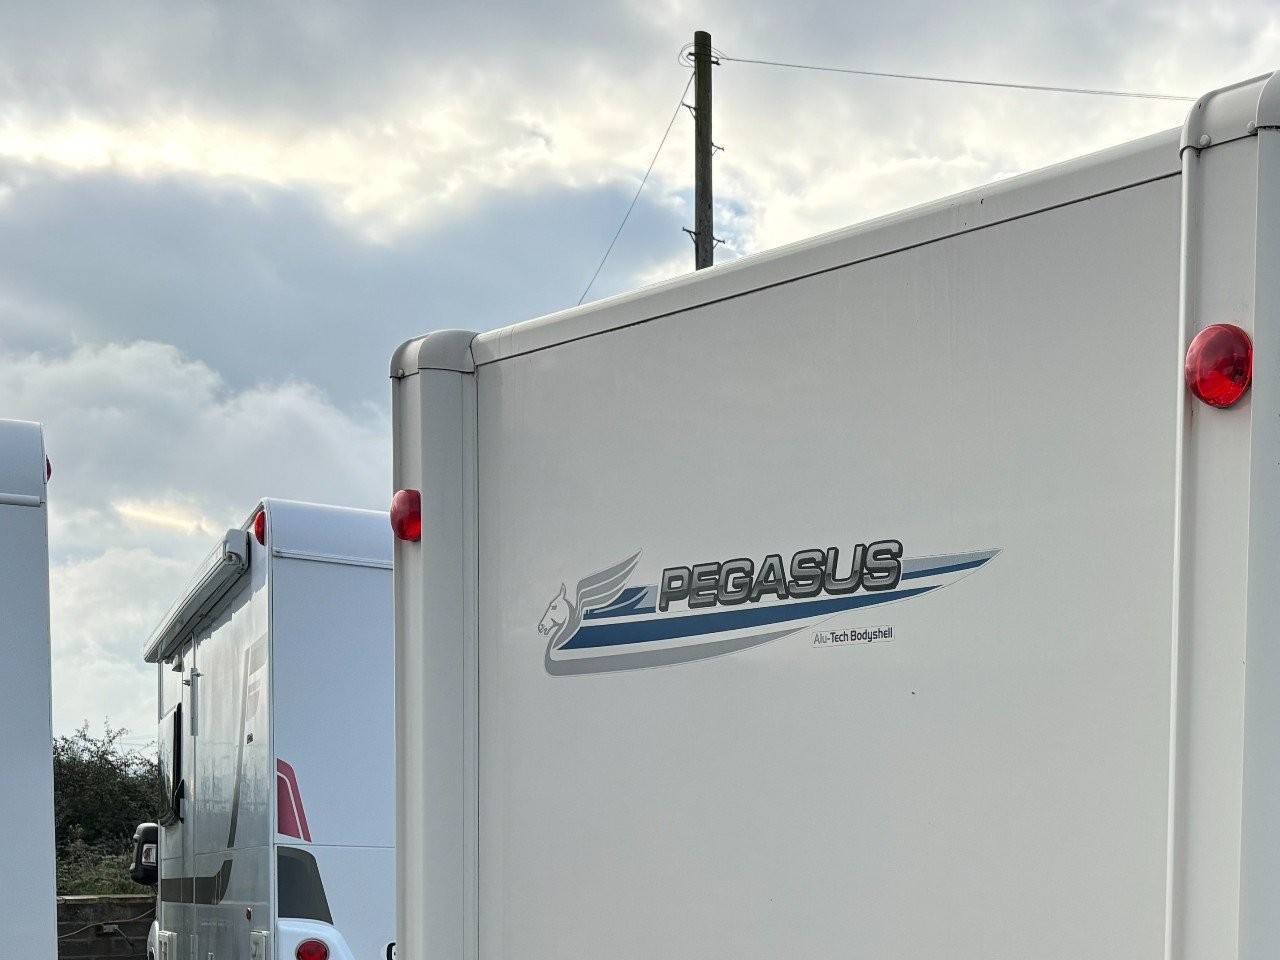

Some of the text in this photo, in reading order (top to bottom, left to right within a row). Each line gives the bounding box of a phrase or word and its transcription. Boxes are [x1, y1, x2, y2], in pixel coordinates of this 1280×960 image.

[657, 540, 903, 612] PEGASUS
[813, 627, 893, 645] Alu-Tech Bodyshell
